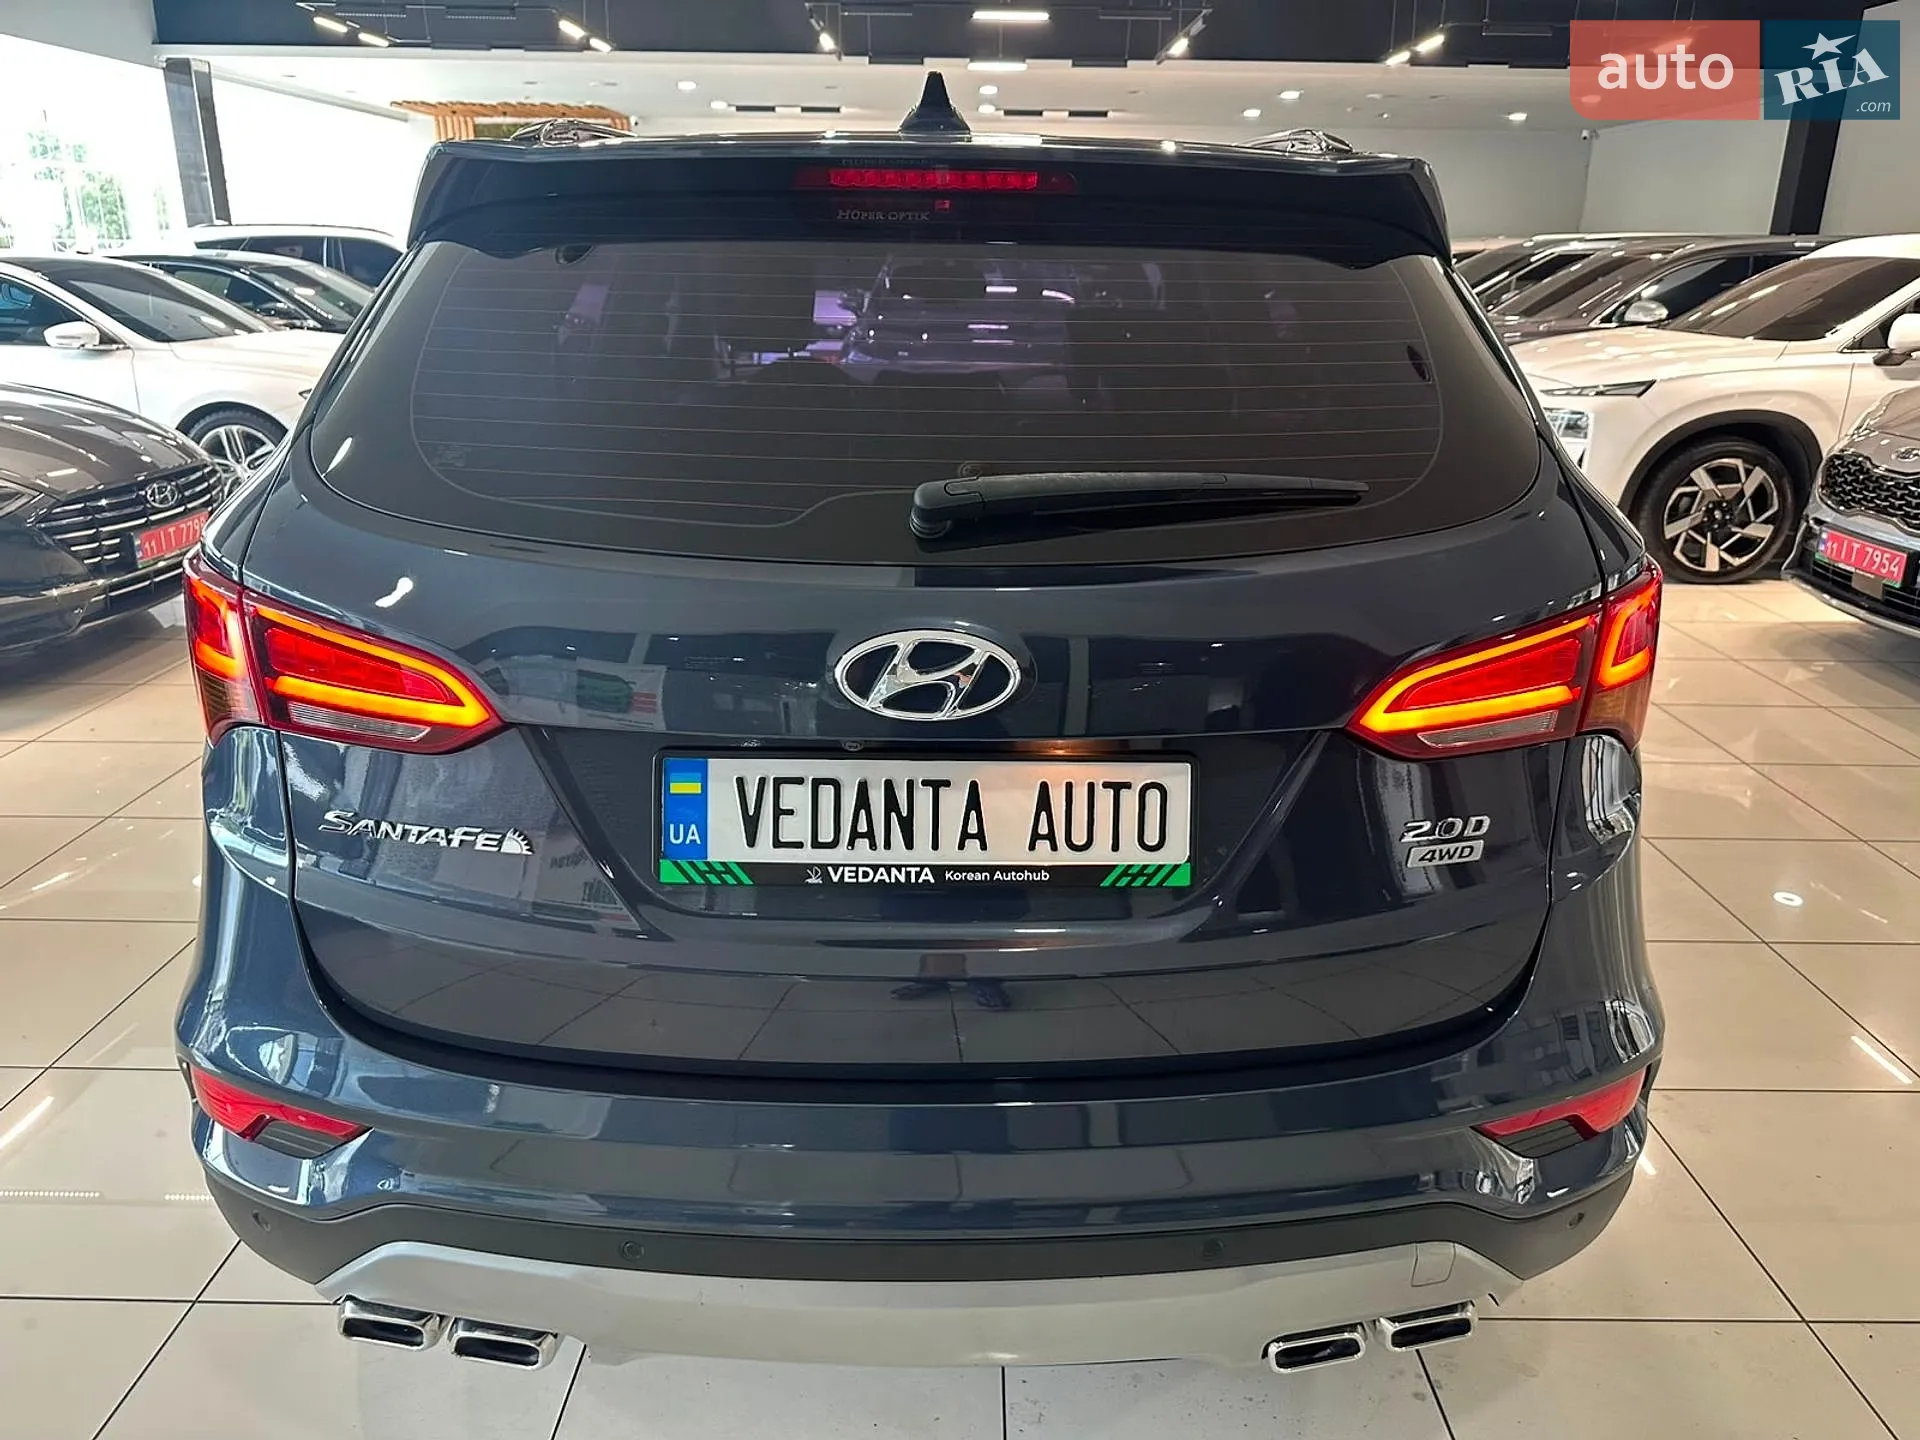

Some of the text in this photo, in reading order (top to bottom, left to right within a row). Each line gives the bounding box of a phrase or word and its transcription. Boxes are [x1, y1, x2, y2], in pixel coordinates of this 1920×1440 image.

[1862, 546, 1901, 577] 7954
[735, 776, 1169, 853] VEDANTA AUTO
[669, 823, 702, 845] UA
[1418, 845, 1474, 863] 4WD
[827, 866, 1050, 884] VEDANTA Korean Autohub
